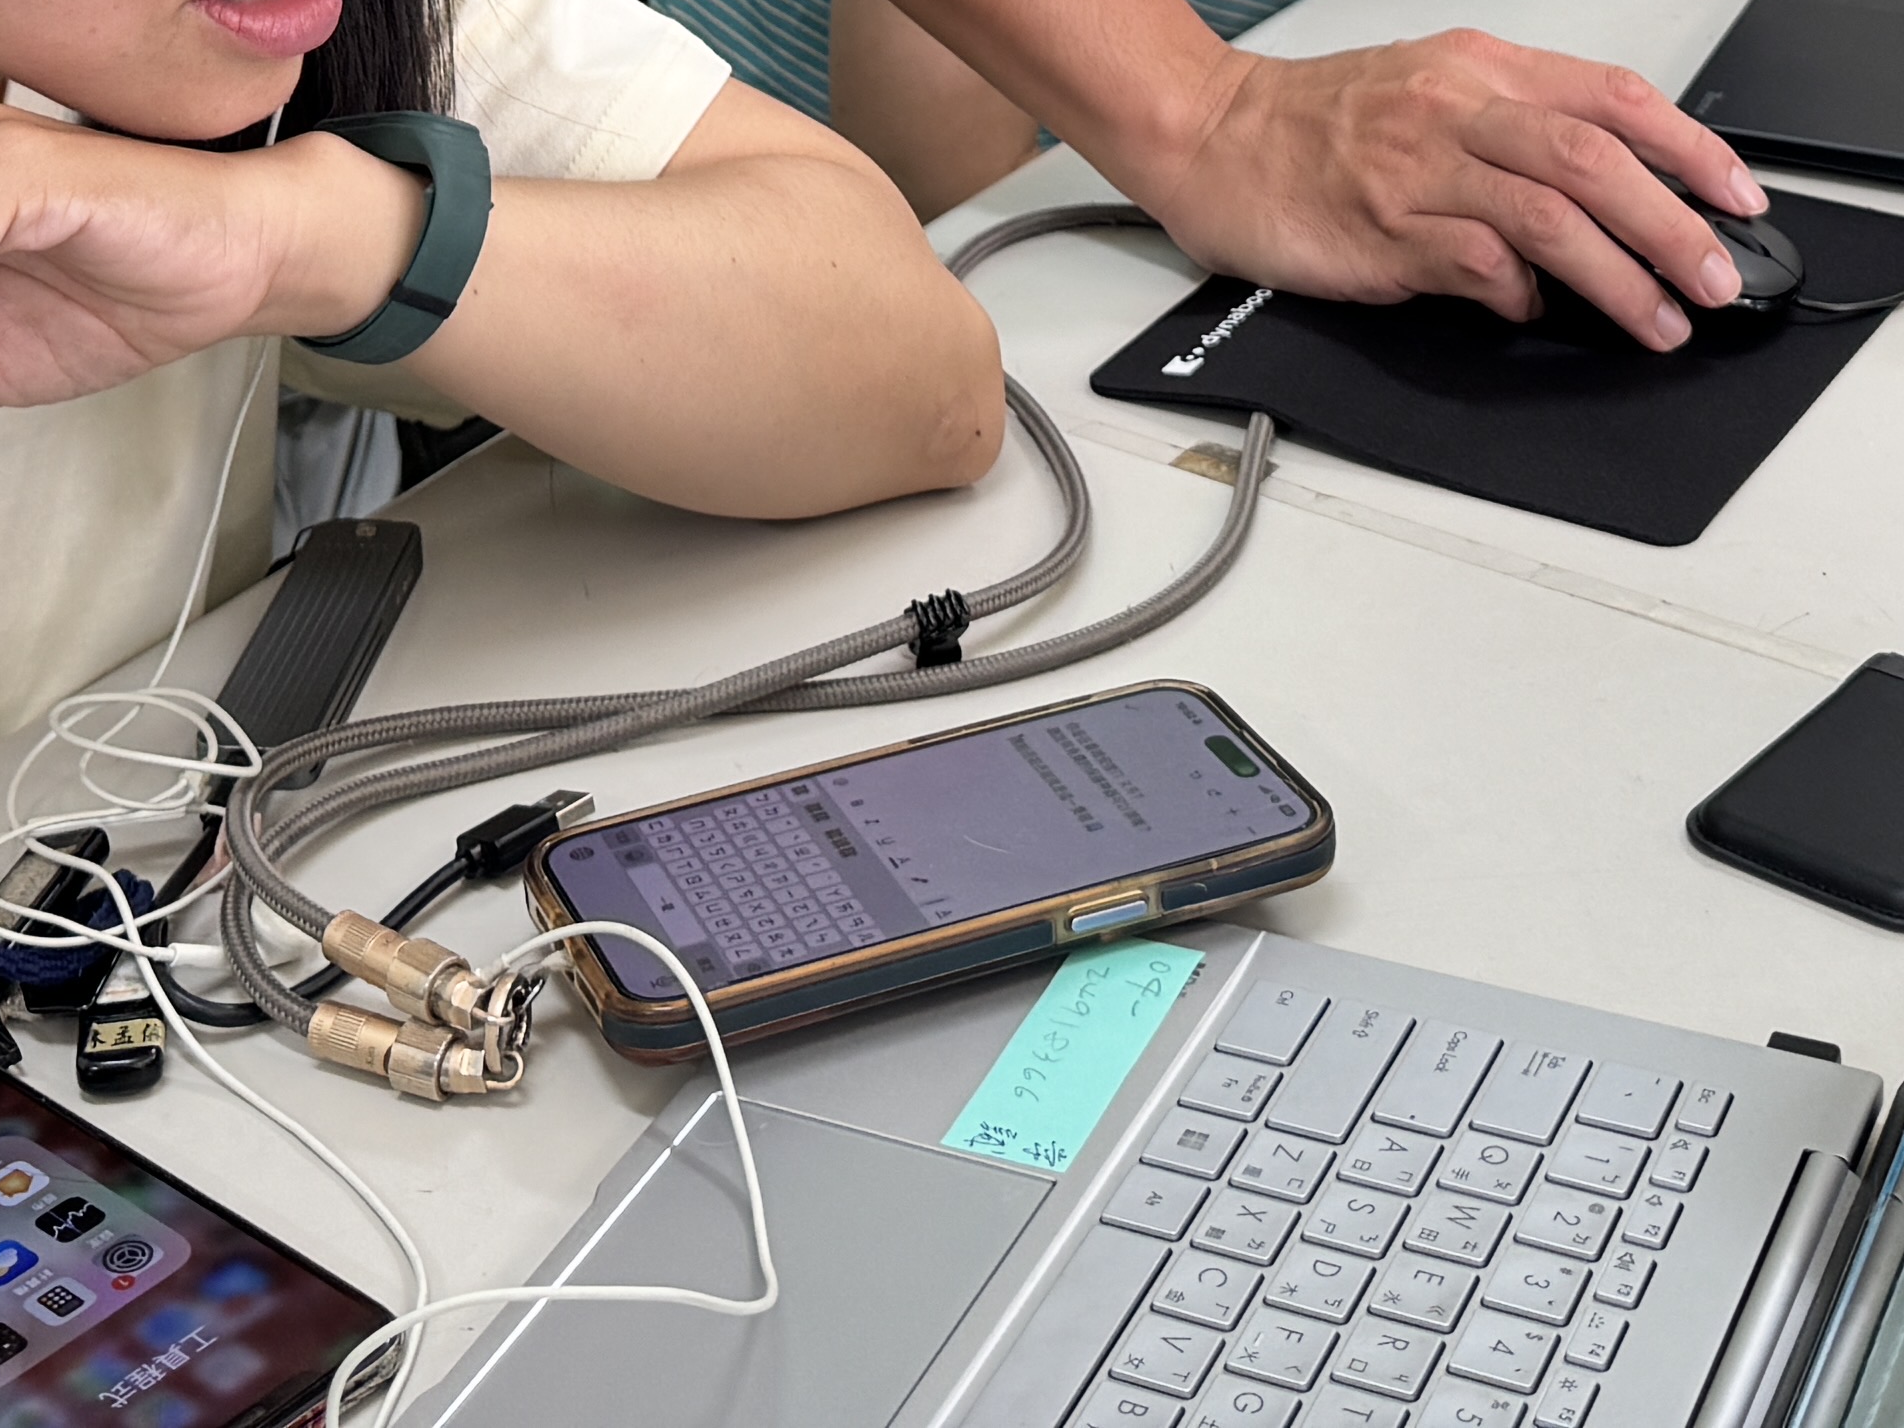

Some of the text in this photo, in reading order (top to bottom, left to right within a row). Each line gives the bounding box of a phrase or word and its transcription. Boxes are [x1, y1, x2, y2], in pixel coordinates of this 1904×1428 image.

[1433, 1030, 1468, 1073] Caps Lock
[1221, 1077, 1240, 1089] Fn
[1697, 1087, 1717, 1105] Esc
[1271, 1143, 1305, 1164] Z
[1377, 1136, 1410, 1153] A
[1477, 1144, 1510, 1167] Q
[1668, 1169, 1691, 1185] F1
[1235, 1204, 1269, 1224] X
[1346, 1198, 1376, 1216] S
[1444, 1204, 1482, 1231] W
[1552, 1210, 1582, 1227] 2
[1643, 1223, 1662, 1238] F2
[1312, 1258, 1343, 1278] D
[1197, 1267, 1229, 1289] C
[1412, 1269, 1446, 1288] E
[1523, 1274, 1551, 1290] 3
[1615, 1282, 1638, 1300] F3
[1274, 1325, 1305, 1345] F
[1377, 1334, 1411, 1352] R
[1159, 1336, 1193, 1354] V
[1487, 1338, 1516, 1357] 4
[1587, 1342, 1609, 1361] F4
[98, 1325, 219, 1408] 工具程式
[1116, 1399, 1150, 1418] B
[1232, 1391, 1265, 1415] G
[1341, 1407, 1375, 1424] T
[1455, 1407, 1485, 1428] 5
[1557, 1406, 1579, 1426] F5
